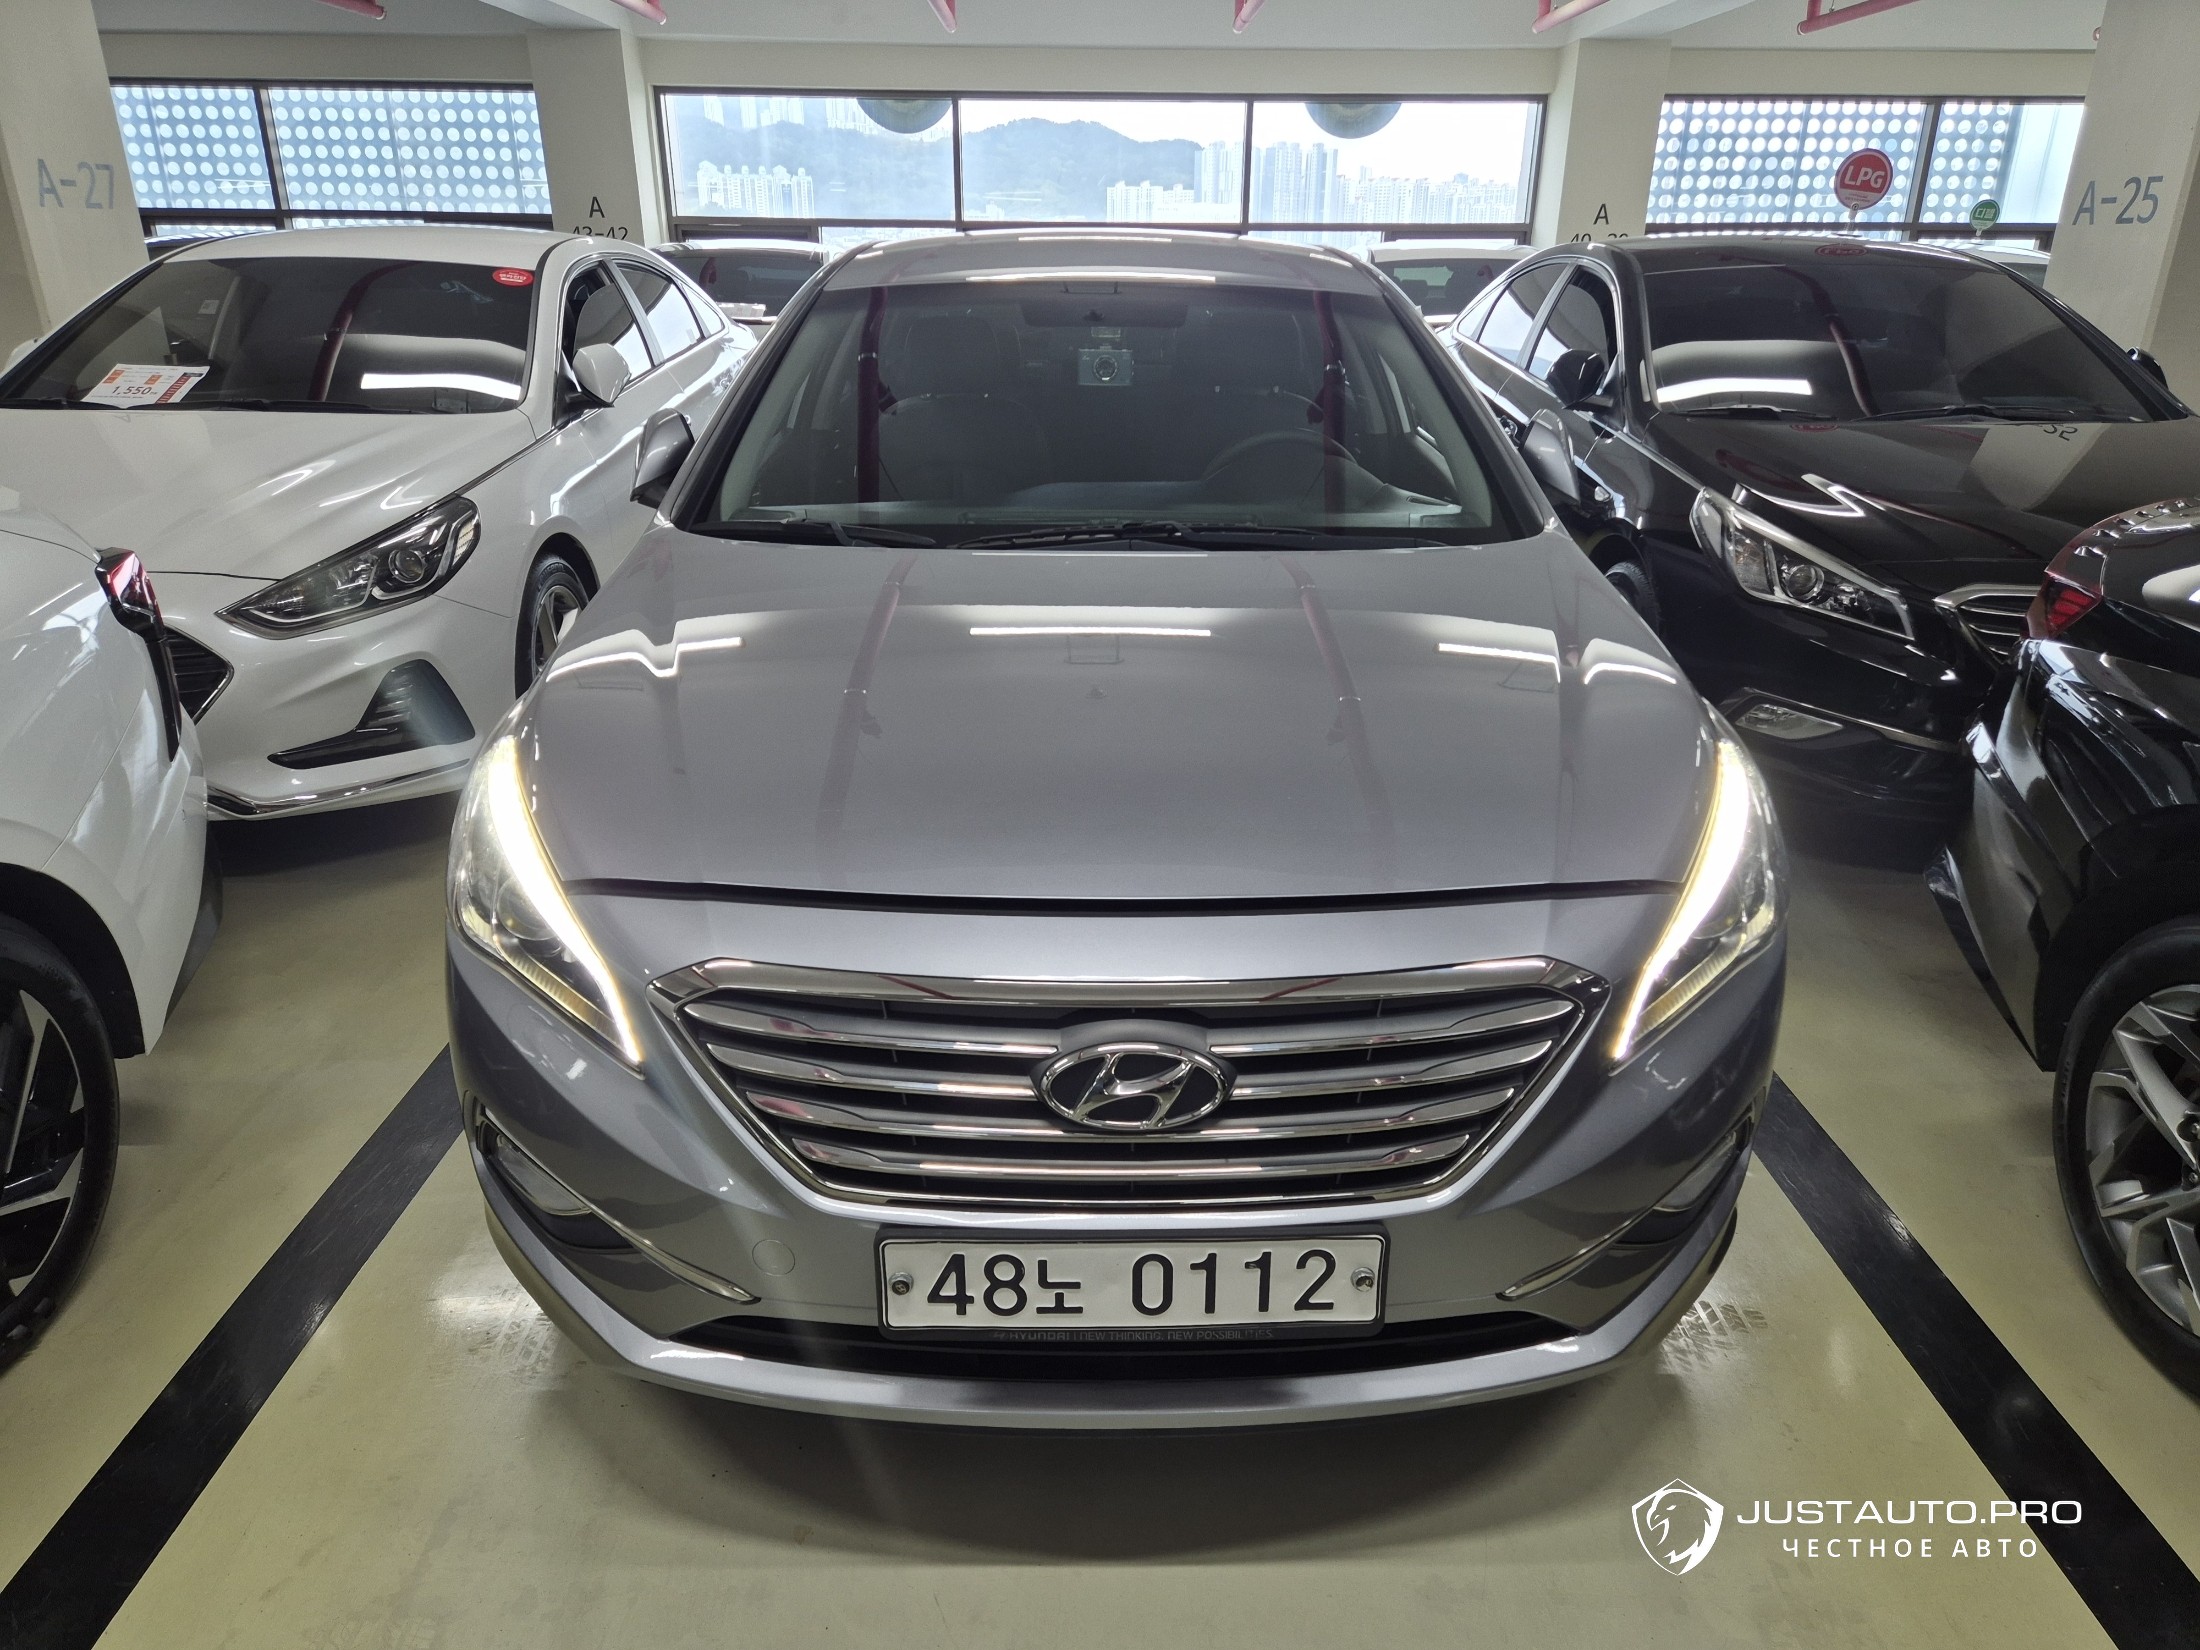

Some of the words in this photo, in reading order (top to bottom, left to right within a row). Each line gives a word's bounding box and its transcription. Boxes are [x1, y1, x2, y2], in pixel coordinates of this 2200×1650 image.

[37, 158, 114, 209] A-27
[1844, 166, 1885, 189] LPG
[589, 196, 605, 218] A
[2071, 175, 2164, 226] A-25
[1593, 203, 1610, 225] A
[111, 386, 153, 395] 1,550
[926, 1253, 1083, 1316] 48노
[1131, 1249, 1335, 1316] 0112
[1009, 1331, 1069, 1341] HYUNDAI
